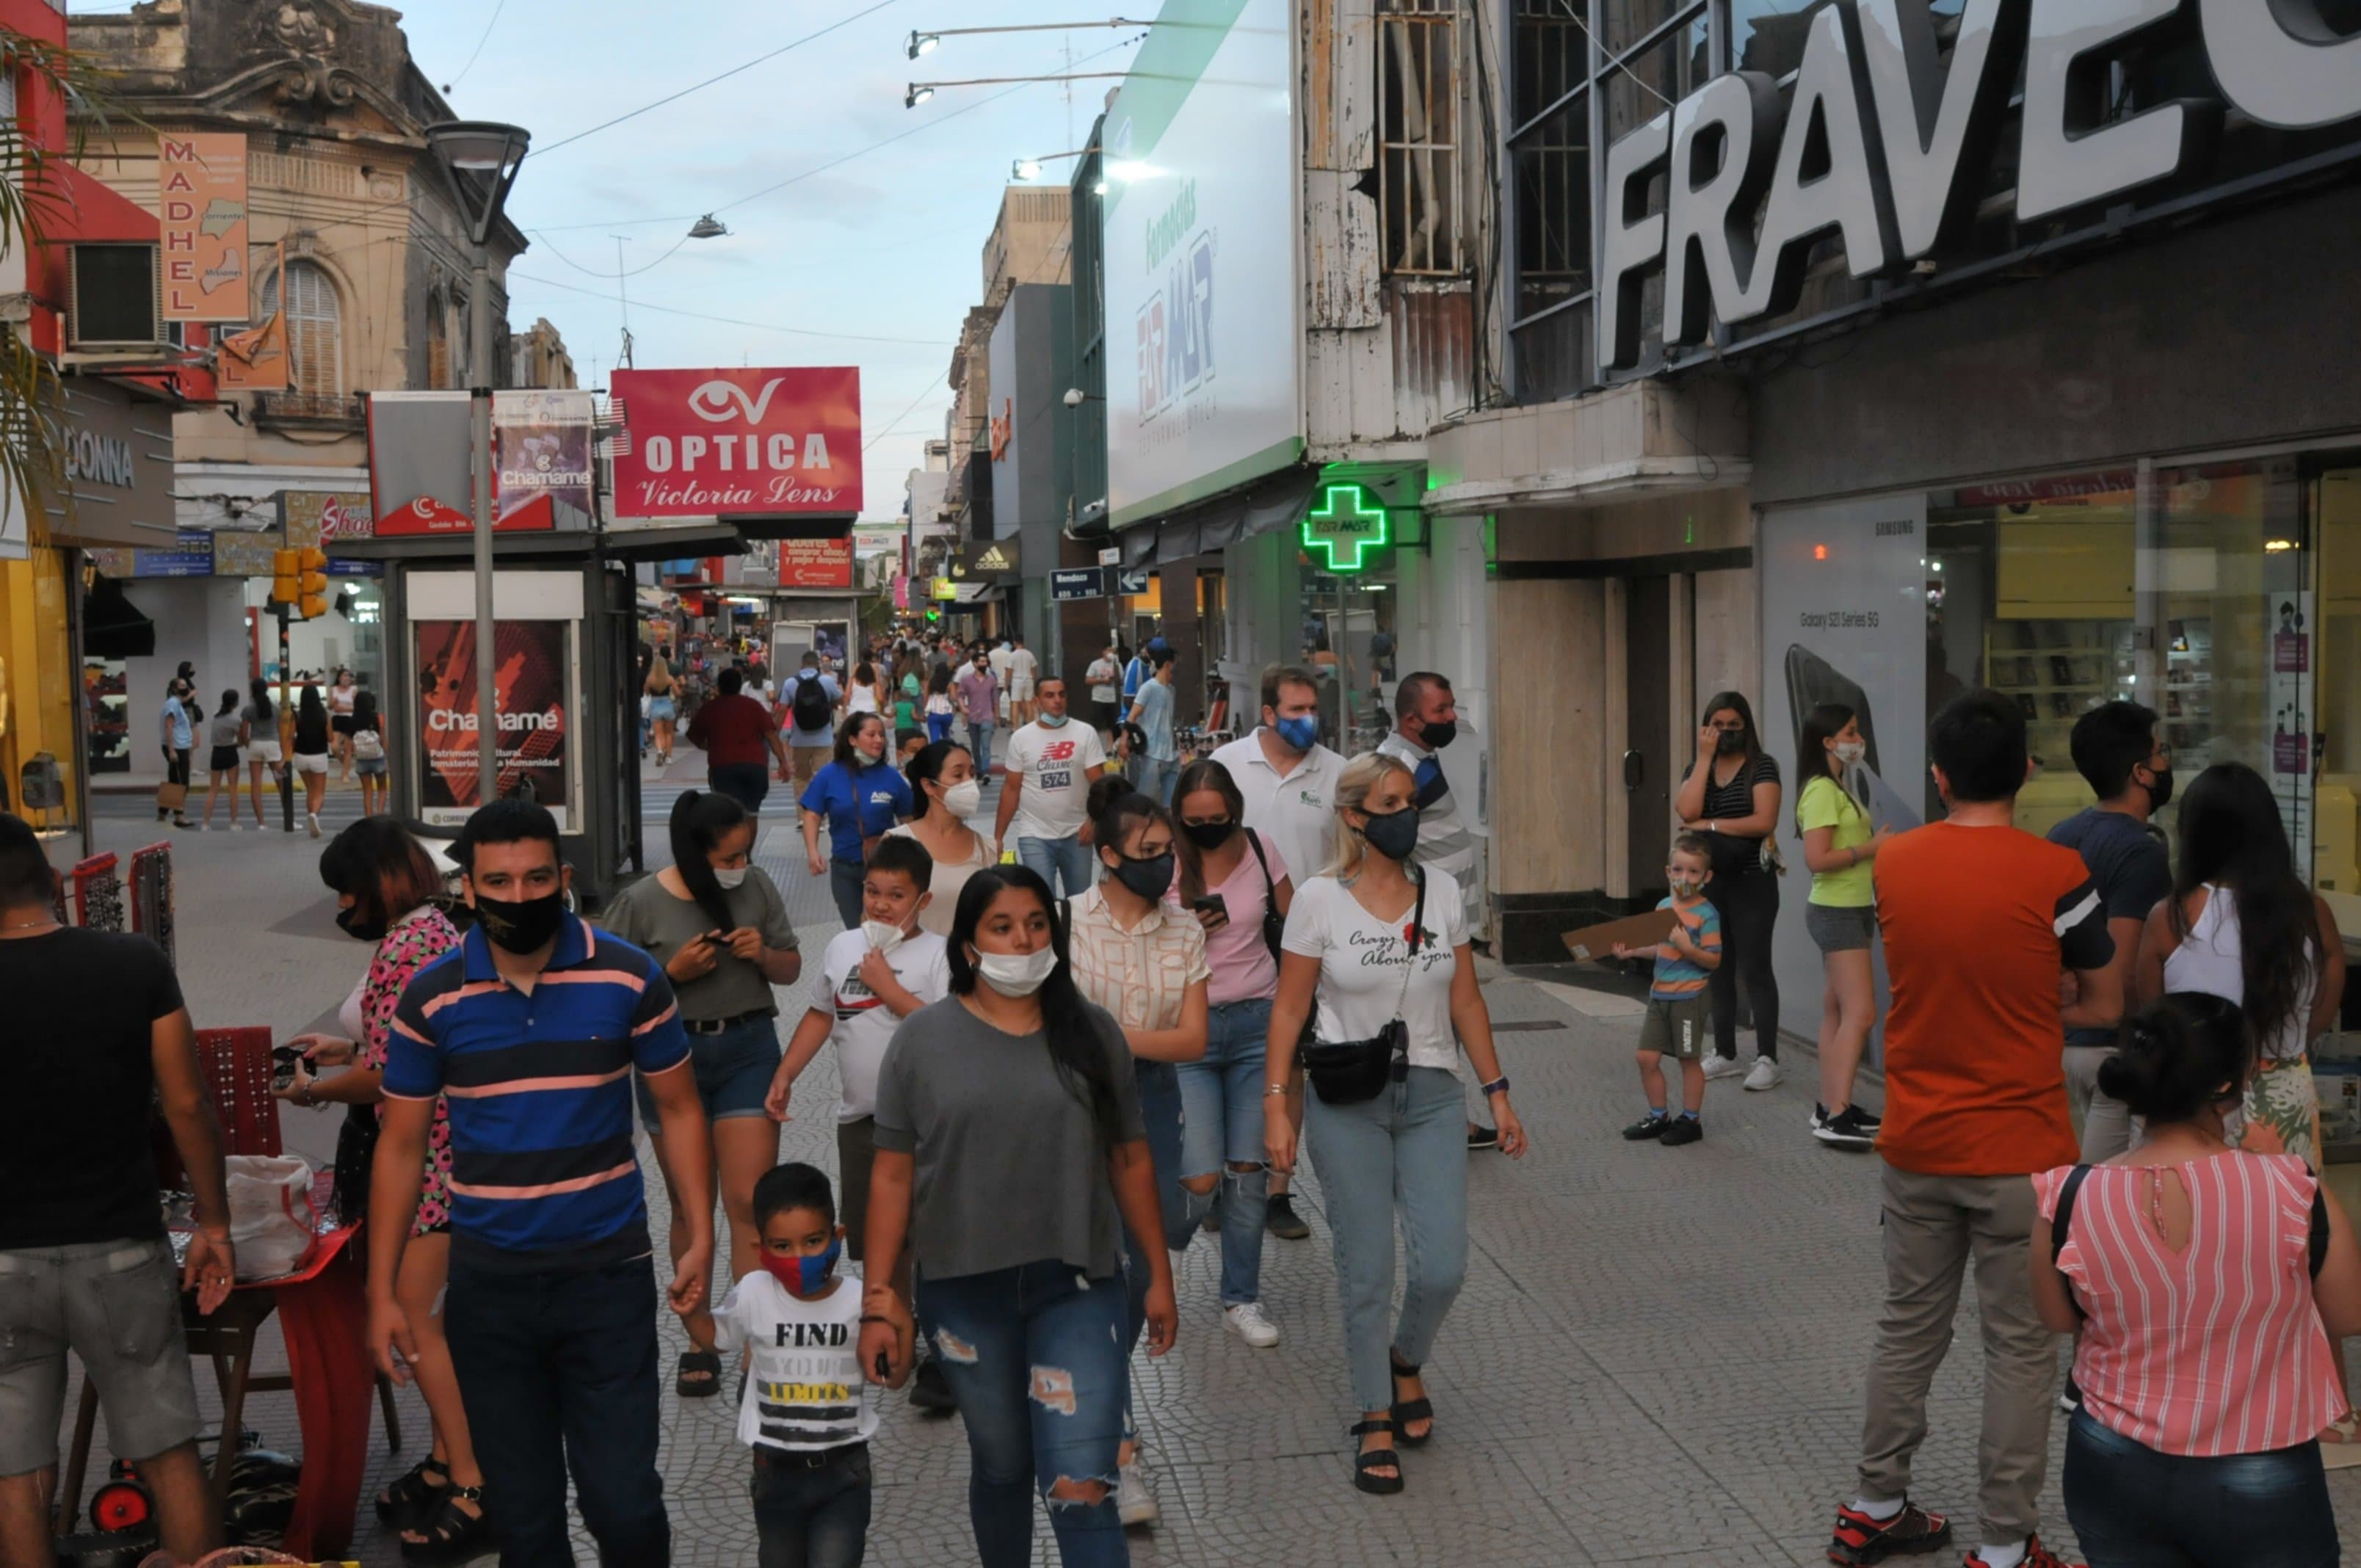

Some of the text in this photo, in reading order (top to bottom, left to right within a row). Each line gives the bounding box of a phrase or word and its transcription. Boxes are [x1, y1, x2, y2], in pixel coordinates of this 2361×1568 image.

[200, 211, 247, 220] Corrientes
[1146, 176, 1197, 275] Farmacias
[162, 142, 196, 311] MADHEL
[205, 268, 243, 277] Misiones
[63, 426, 134, 488] DONNA
[645, 433, 830, 473] OPTICA
[501, 470, 591, 485] Chamamé
[637, 476, 841, 507] Victoria Lens
[1876, 520, 1913, 537] SAMSUNG
[975, 562, 1009, 570] adidas
[1056, 573, 1088, 583] Mendoza
[1800, 611, 1879, 631] Galaxy S21 Series 5G
[430, 758, 479, 767] Inmaterial
[505, 758, 559, 767] Humanidad
[1044, 773, 1067, 787] 574
[1349, 930, 1396, 952] Crazy
[1361, 950, 1452, 972] Abou you
[775, 1323, 848, 1347] FIND
[775, 1357, 843, 1377] YOUR
[770, 1382, 849, 1404] LIMITS
